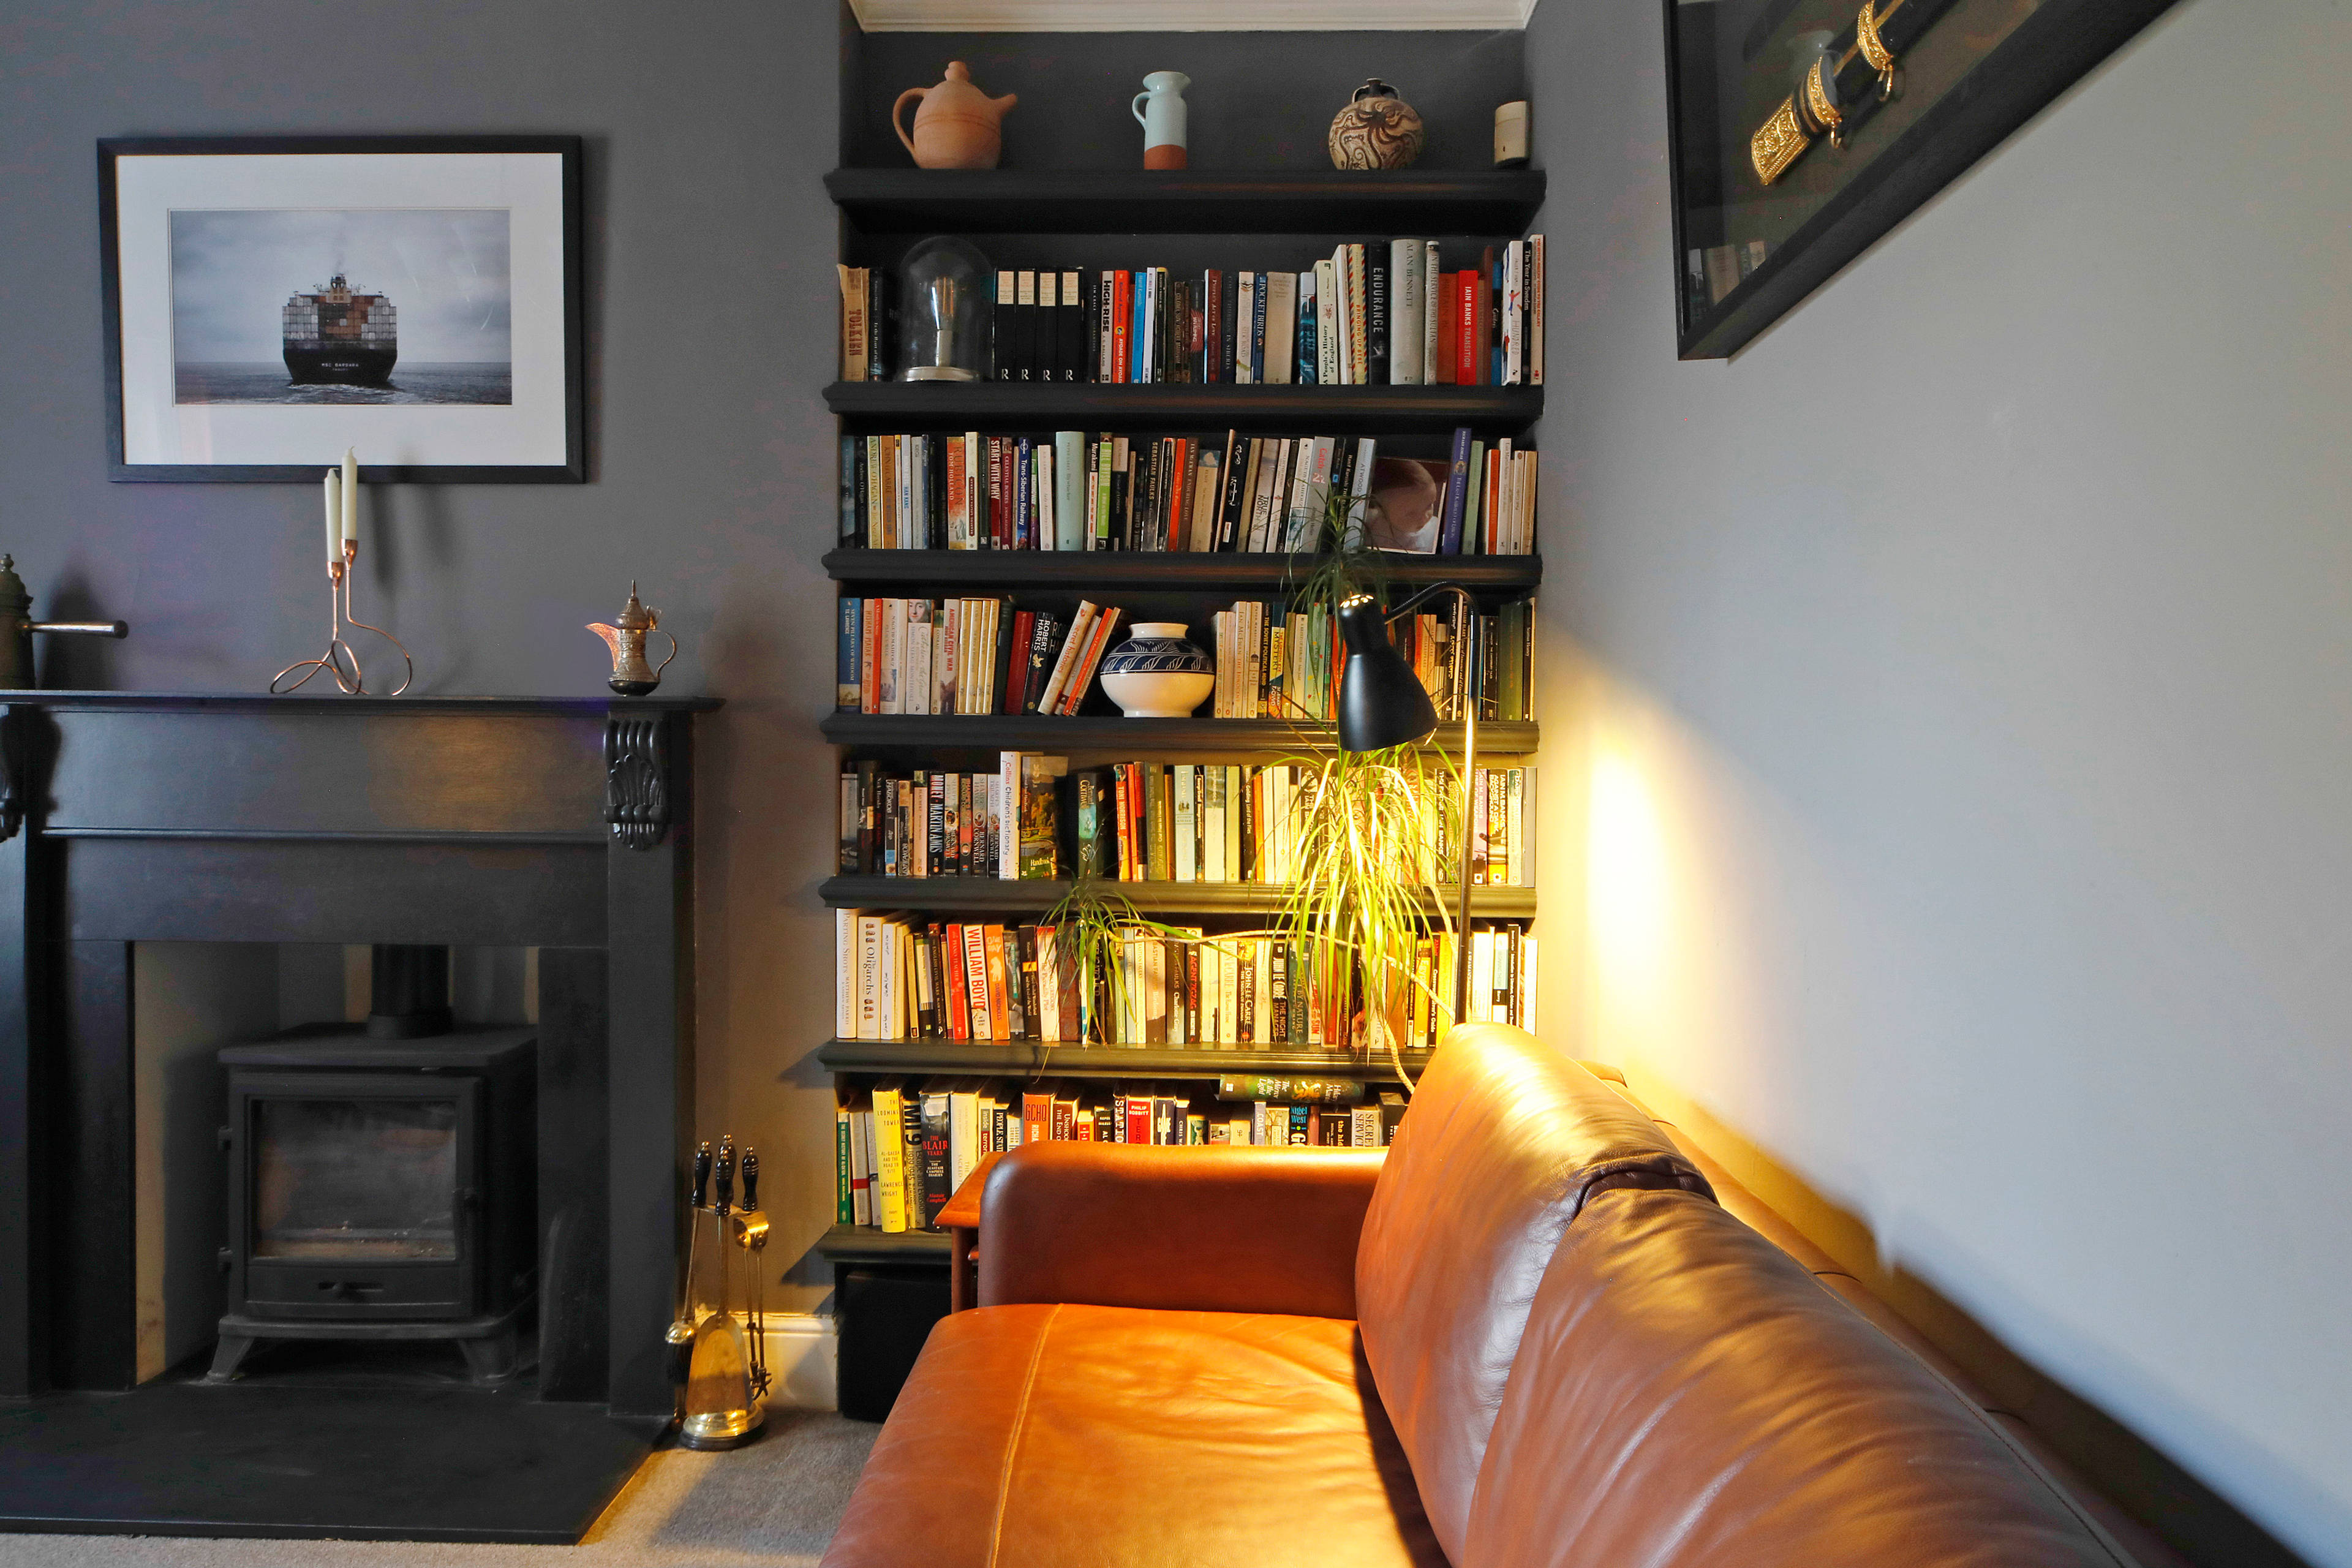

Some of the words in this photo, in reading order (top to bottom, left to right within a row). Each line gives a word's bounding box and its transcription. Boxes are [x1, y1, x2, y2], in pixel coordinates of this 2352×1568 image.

[1102, 281, 1112, 332] HIGH-RISE
[1373, 268, 1383, 333] ENDURANCE
[849, 309, 862, 356] TOLKIEN
[1357, 339, 1362, 347] UP
[1330, 364, 1335, 373] of
[990, 440, 1000, 462] START
[954, 447, 963, 505] RUBICON
[990, 463, 1000, 481] WITH
[990, 483, 1000, 500] WHY
[1034, 619, 1044, 651] HARRIS
[1041, 620, 1050, 652] ROBERT
[1068, 624, 1082, 645] secret
[931, 775, 943, 799] MONEY
[1080, 780, 1090, 809] Cornwell
[930, 803, 943, 832] MARTIN
[930, 834, 943, 853] AMIS
[967, 929, 983, 976] WILLIAM
[864, 947, 875, 995] Oligarchs
[1244, 967, 1253, 989] JOHN
[971, 980, 986, 1008] BOYD
[1257, 1078, 1265, 1095] Light
[1025, 1104, 1047, 1121] GCHQ
[922, 1140, 948, 1150] BLAIR
